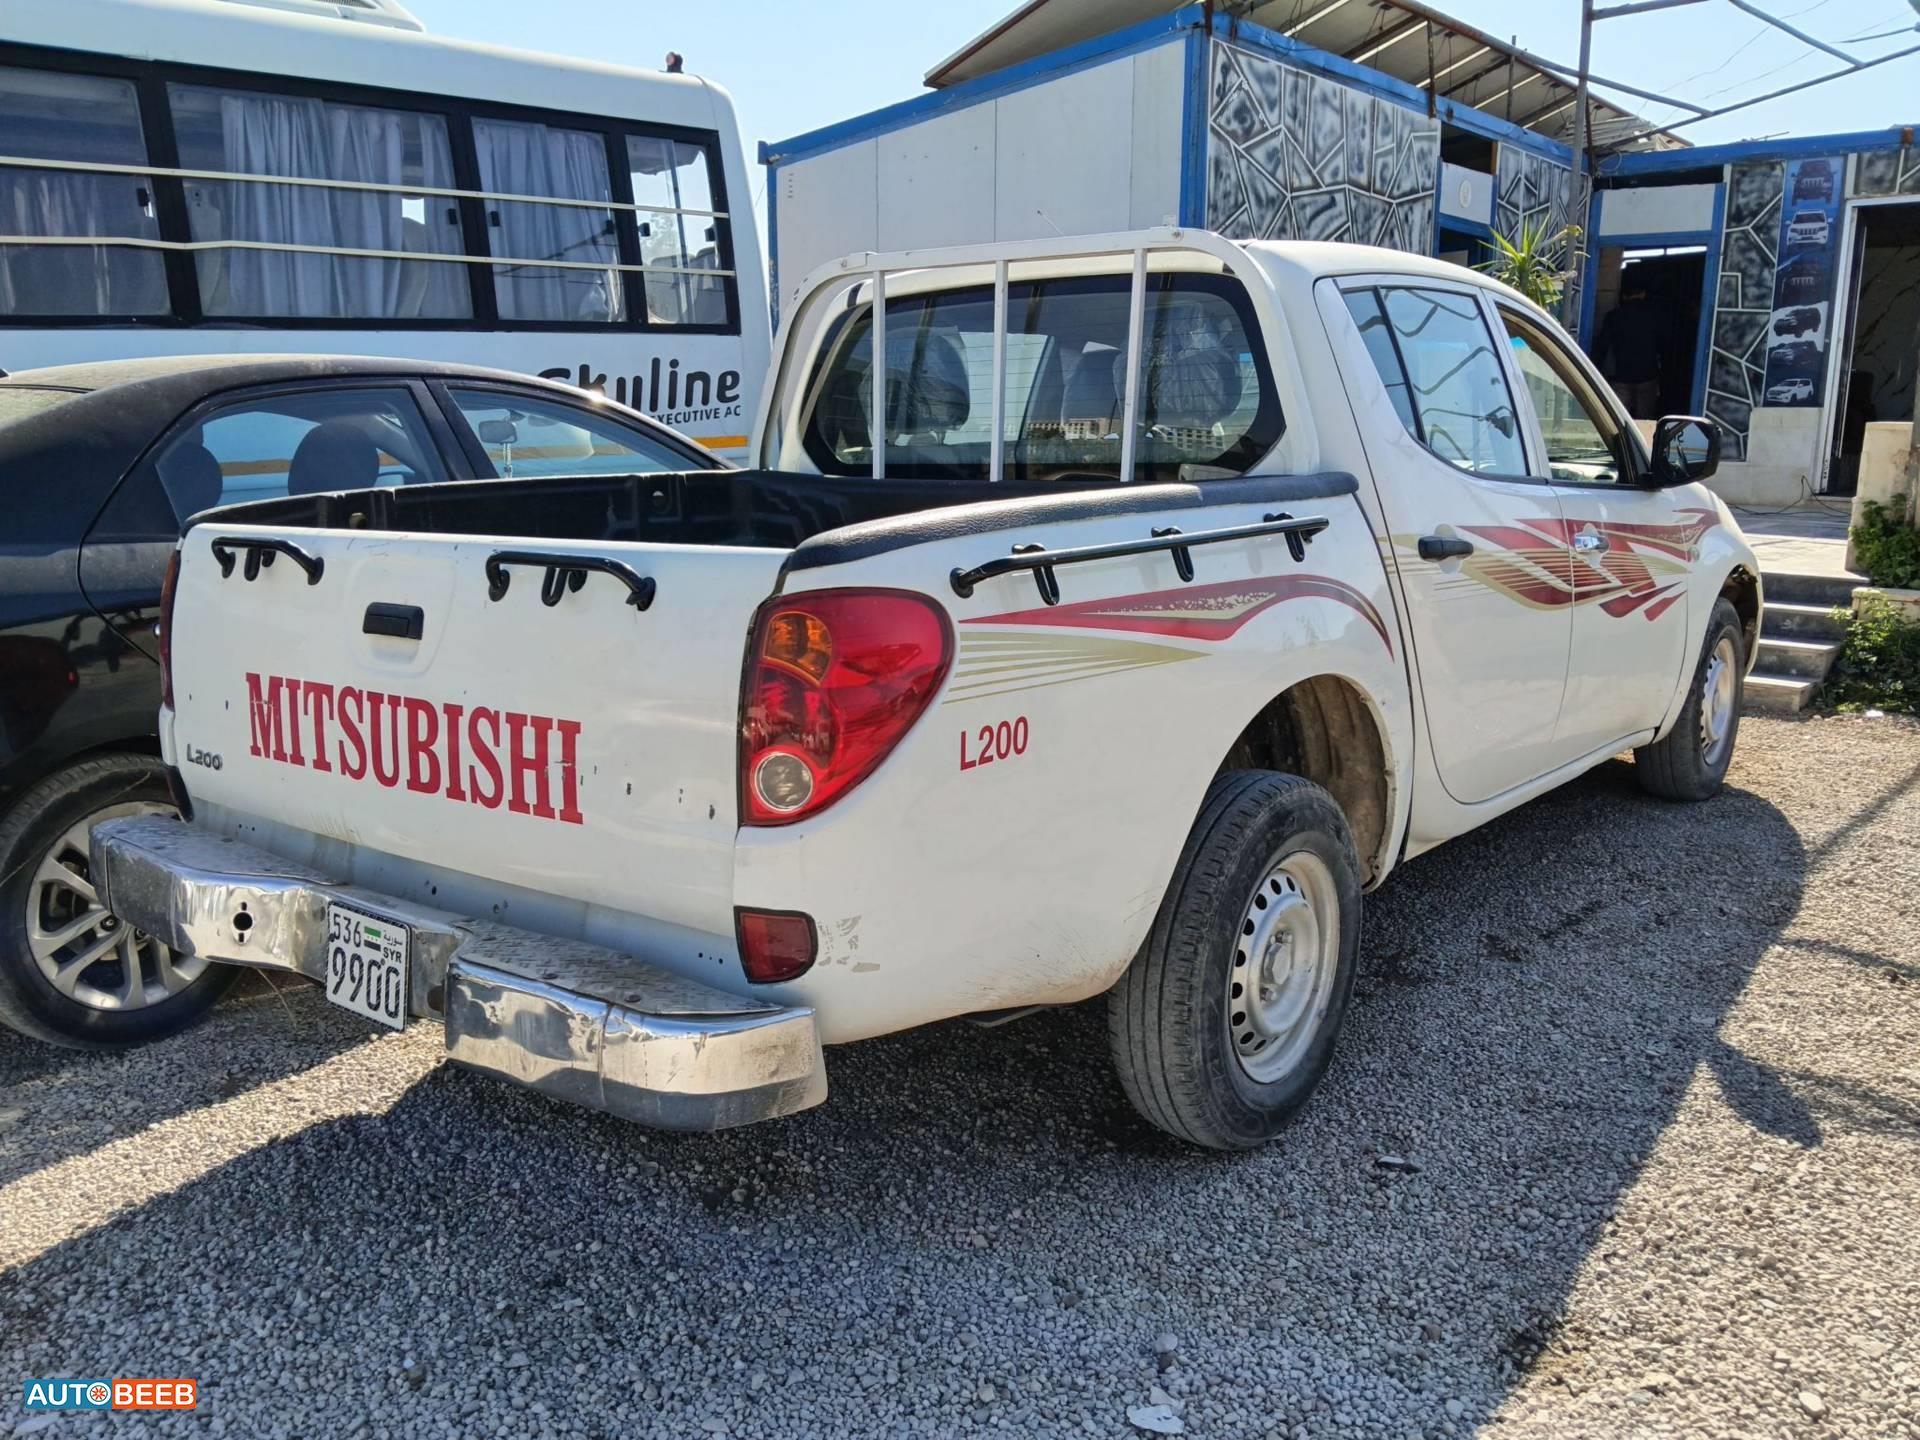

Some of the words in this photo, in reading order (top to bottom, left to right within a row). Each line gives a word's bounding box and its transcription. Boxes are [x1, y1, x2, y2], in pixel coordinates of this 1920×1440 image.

[537, 357, 740, 412] kyline
[650, 407, 721, 426] XECUTIVE
[724, 405, 741, 418] AC
[186, 743, 223, 771] L200
[245, 672, 584, 825] MITSUBISHI
[960, 716, 1029, 771] L200
[333, 912, 361, 948] 536
[383, 946, 402, 964] SYR
[332, 946, 401, 1019] 9900
